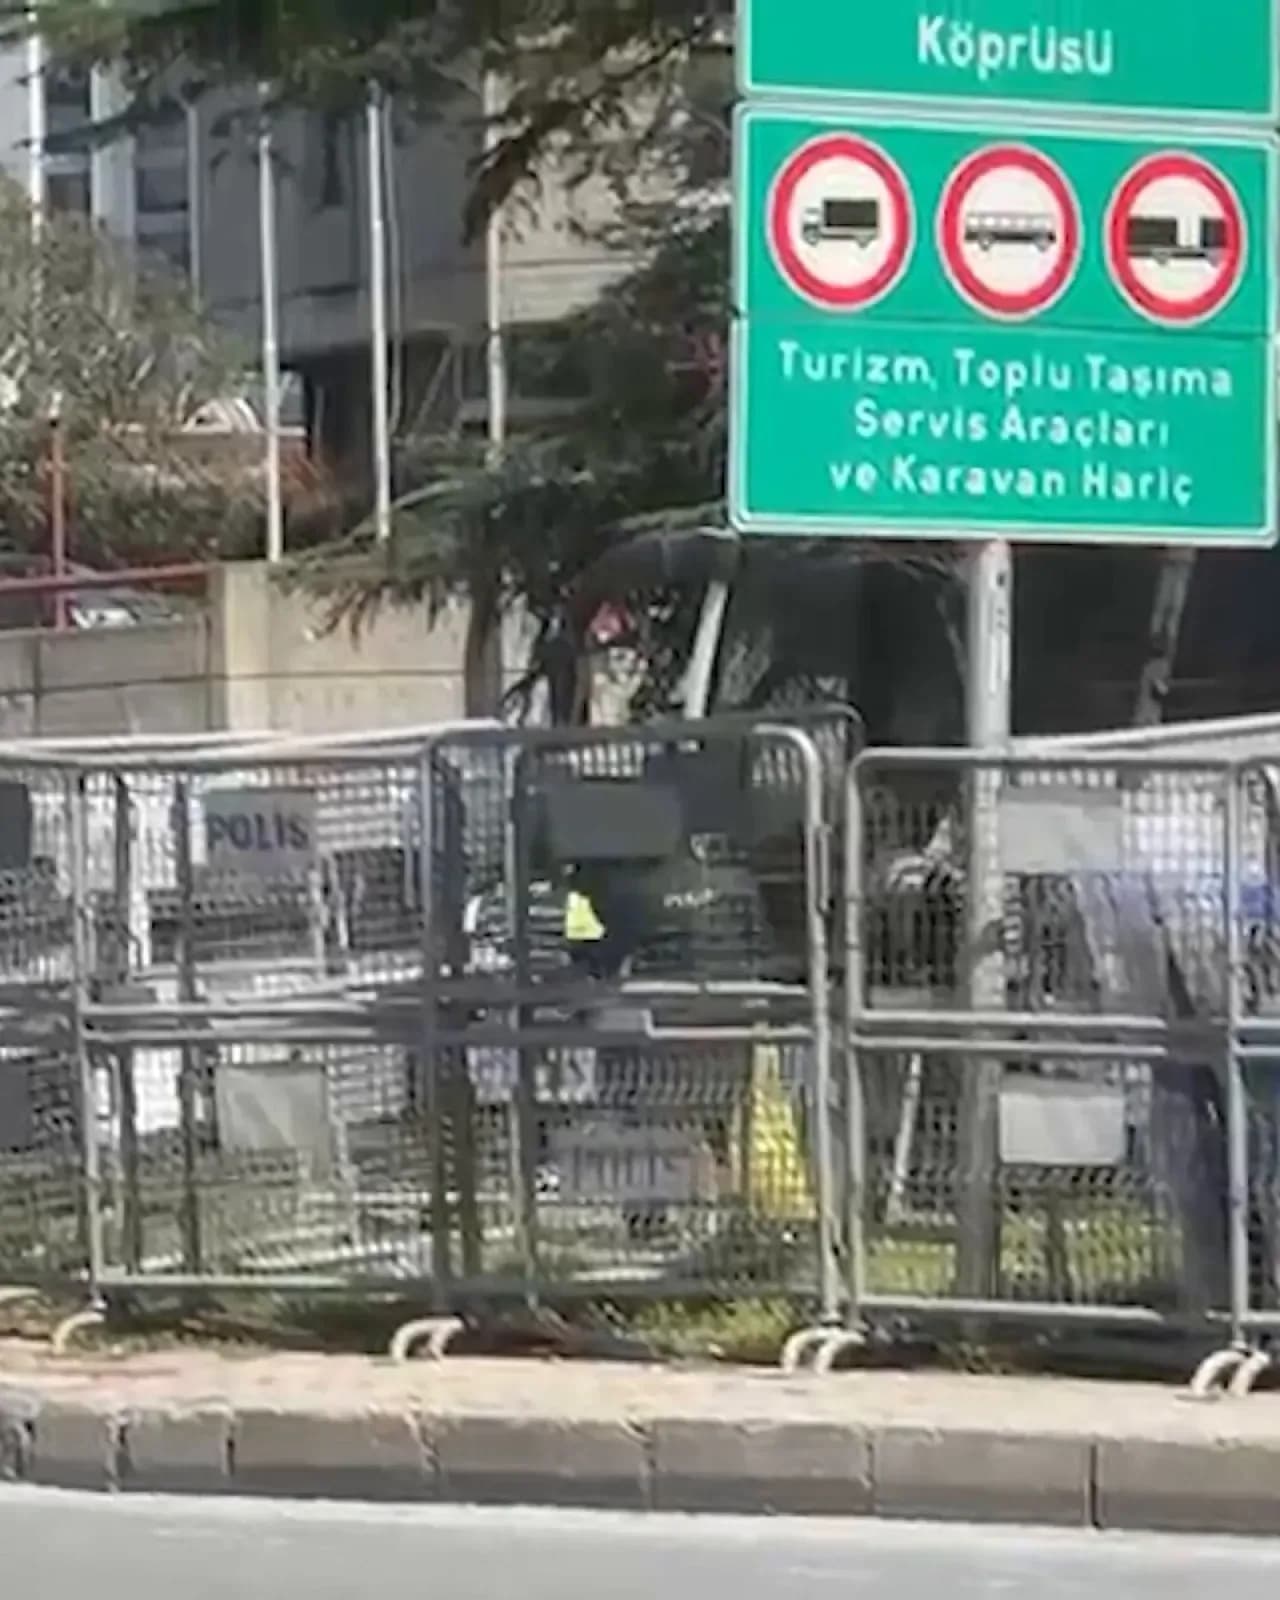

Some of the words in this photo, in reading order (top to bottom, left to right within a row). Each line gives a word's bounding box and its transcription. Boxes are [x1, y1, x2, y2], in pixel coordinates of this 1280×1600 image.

[917, 14, 1113, 81] Köprüsü
[953, 348, 1072, 398] Toplu
[1085, 353, 1232, 398] Taşıma
[855, 397, 988, 441] Servis
[1000, 404, 1169, 448] Araçları
[829, 462, 878, 491] ve
[892, 454, 1065, 497] Karavan
[1083, 463, 1192, 506] Hariç
